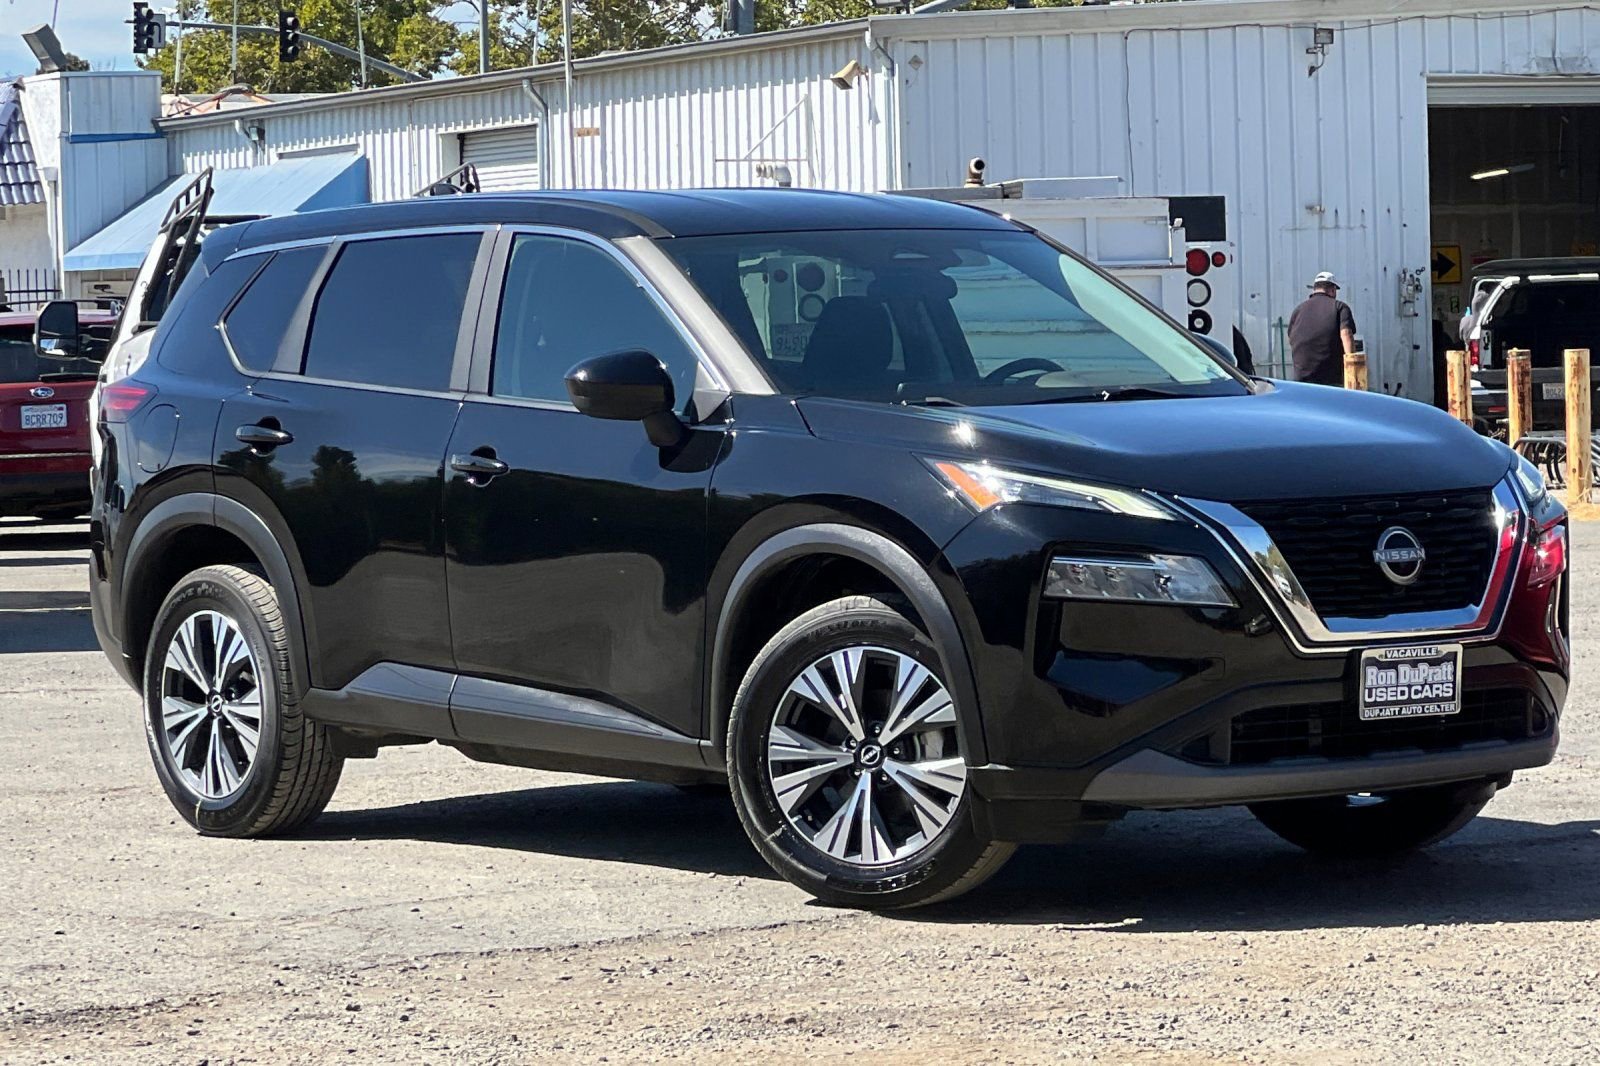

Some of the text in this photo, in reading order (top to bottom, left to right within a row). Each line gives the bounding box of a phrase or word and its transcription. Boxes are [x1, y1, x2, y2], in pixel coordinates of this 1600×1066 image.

[1376, 549, 1425, 561] NISSAN
[1386, 647, 1437, 658] VACAVILLE
[1366, 661, 1454, 687] Ron DuPratt
[1365, 683, 1453, 702] USED CARS
[1401, 705, 1422, 715] AUTO
[1424, 703, 1455, 712] CENTER
